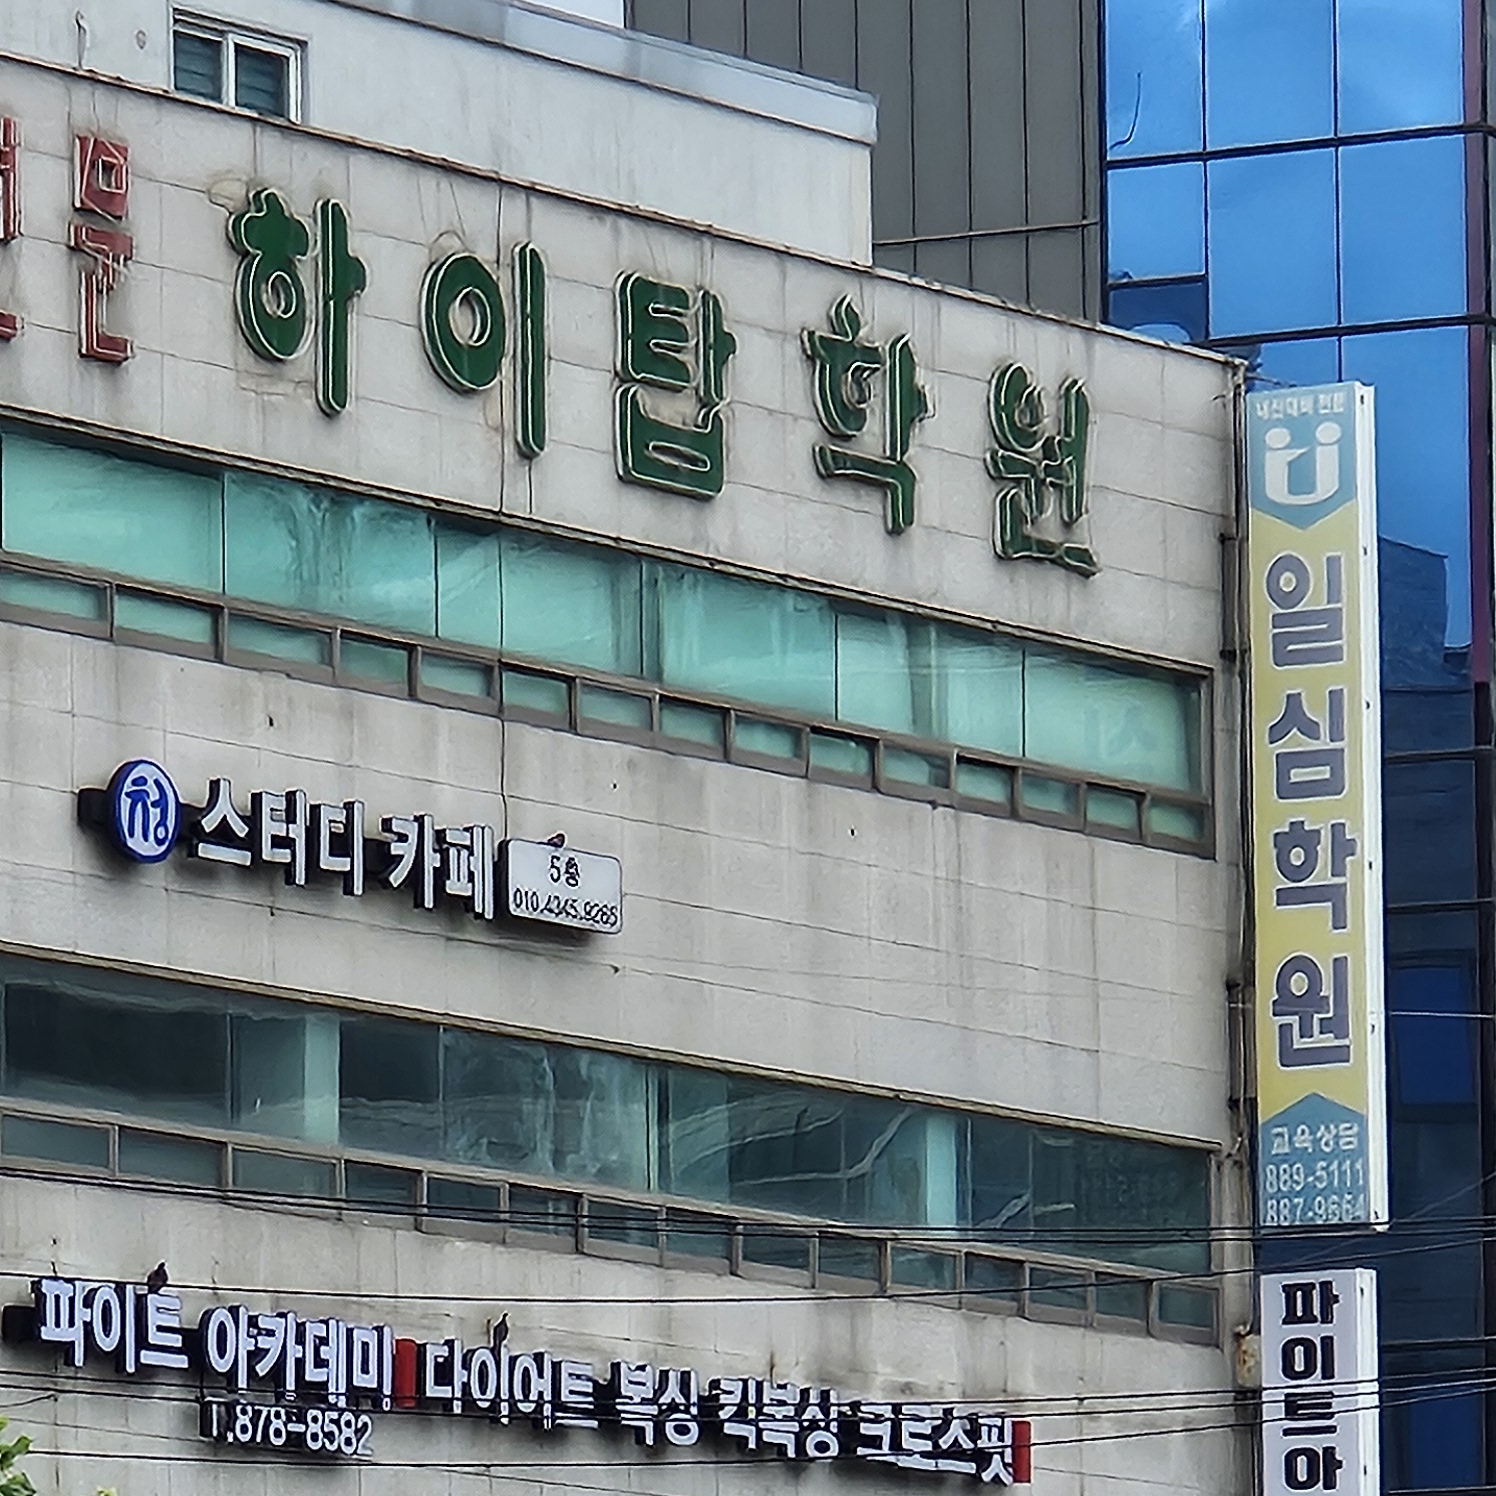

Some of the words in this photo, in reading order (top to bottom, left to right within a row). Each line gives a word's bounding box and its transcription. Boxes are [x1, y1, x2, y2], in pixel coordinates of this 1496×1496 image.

[228, 188, 1099, 577] 하이탑학원
[197, 777, 364, 896] 스터디
[384, 813, 495, 920] 카페
[1265, 551, 1357, 1068] 일심학원
[1271, 1122, 1360, 1155] 교육상담
[40, 1278, 190, 1374] 파이트
[207, 1304, 394, 1411] 아카데미
[425, 1338, 599, 1432] 다이어트
[615, 1360, 700, 1447] 복싱
[718, 1377, 840, 1459] 킥복싱
